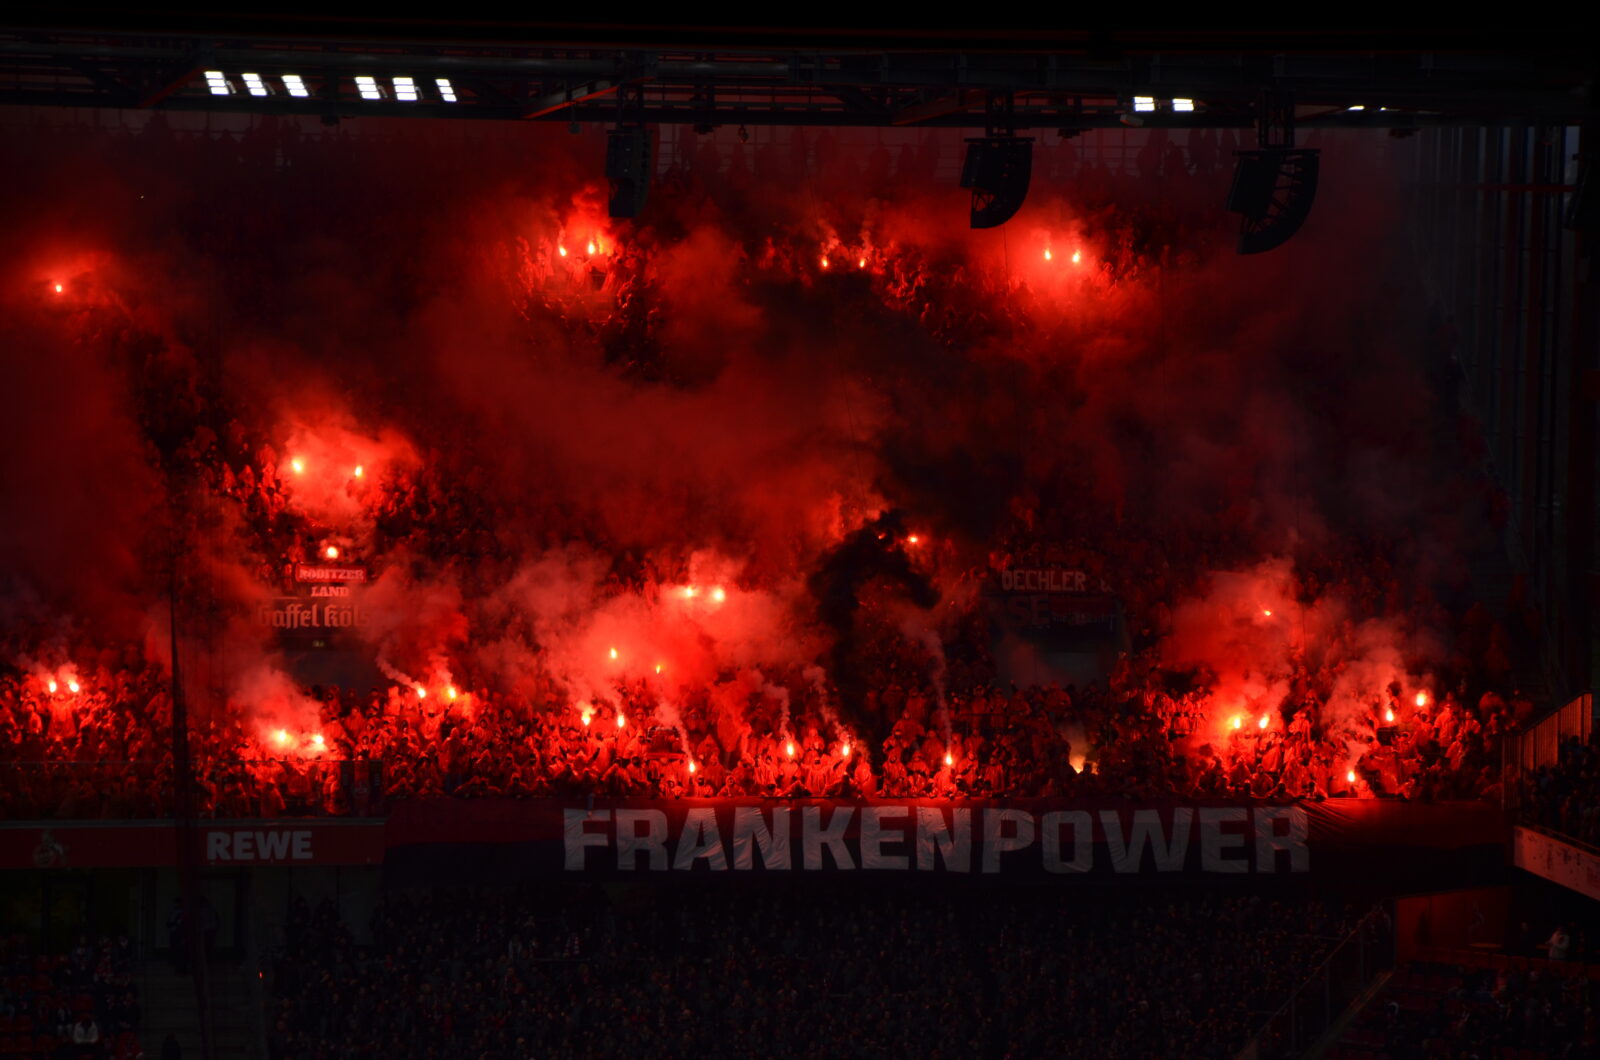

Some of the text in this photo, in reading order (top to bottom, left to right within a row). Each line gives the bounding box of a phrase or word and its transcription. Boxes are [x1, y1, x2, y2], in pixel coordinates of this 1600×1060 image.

[311, 586, 349, 598] LAND
[206, 830, 314, 861] REWE
[562, 805, 1311, 875] FRANKENPOWER
